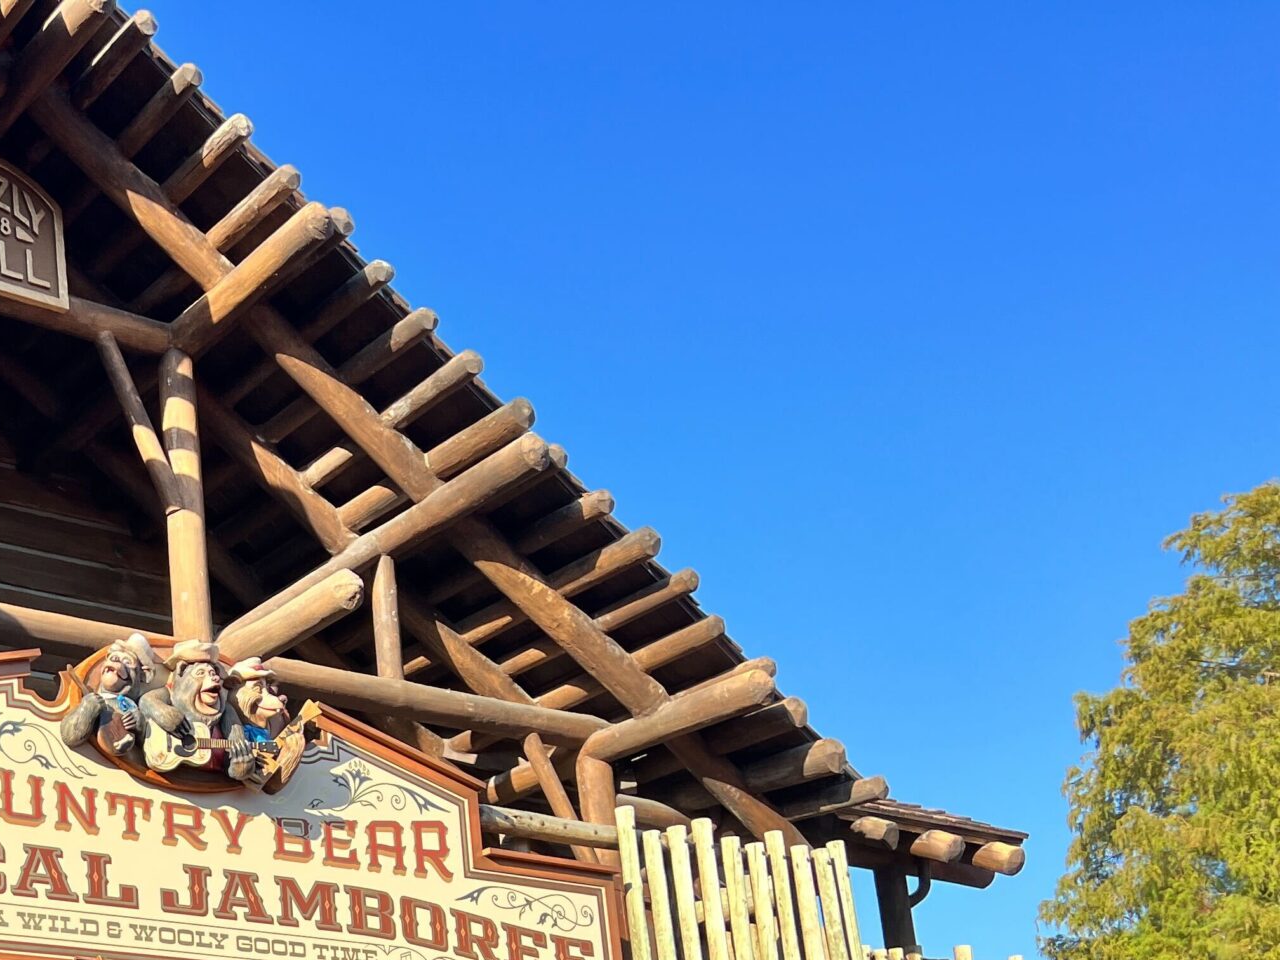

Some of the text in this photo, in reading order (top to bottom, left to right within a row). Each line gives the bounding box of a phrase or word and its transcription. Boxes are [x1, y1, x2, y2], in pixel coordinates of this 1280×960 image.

[272, 816, 454, 883] BEAR
[16, 911, 99, 937] WILD
[107, 924, 123, 938] &
[129, 923, 229, 950] WOOLY
[236, 935, 307, 958] GOOD
